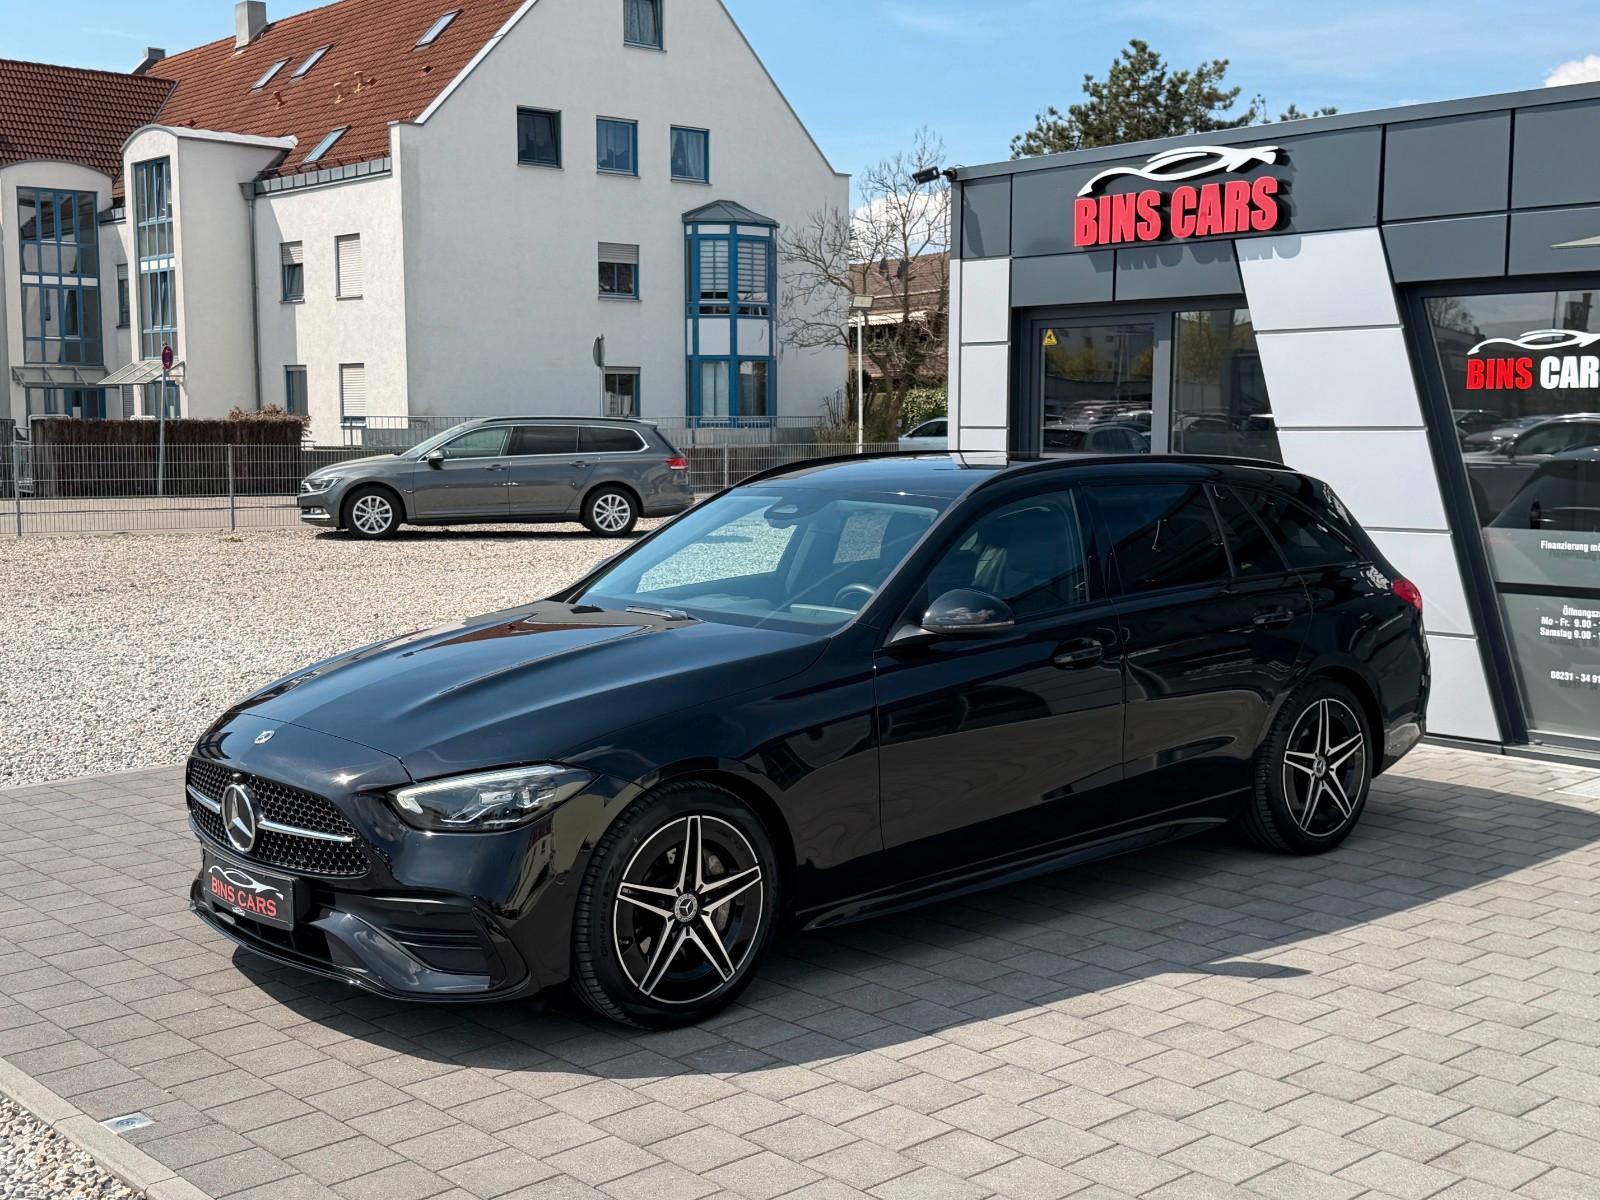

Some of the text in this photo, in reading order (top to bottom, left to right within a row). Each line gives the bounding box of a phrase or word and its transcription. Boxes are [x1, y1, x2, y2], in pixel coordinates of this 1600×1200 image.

[1074, 176, 1278, 247] BINS CARS
[1466, 355, 1600, 390] BINS CAR
[1540, 540, 1589, 552] Finanzierung
[1562, 604, 1600, 618] Öffnungsz
[1541, 616, 1554, 625] Mo
[1560, 617, 1570, 627] Fr.
[1574, 619, 1592, 628] 9.00
[1539, 627, 1572, 639] Samstag
[1573, 630, 1592, 639] 9.00
[1550, 670, 1573, 680] 08231
[1580, 673, 1591, 682] 34
[211, 876, 277, 917] BINS CARS
